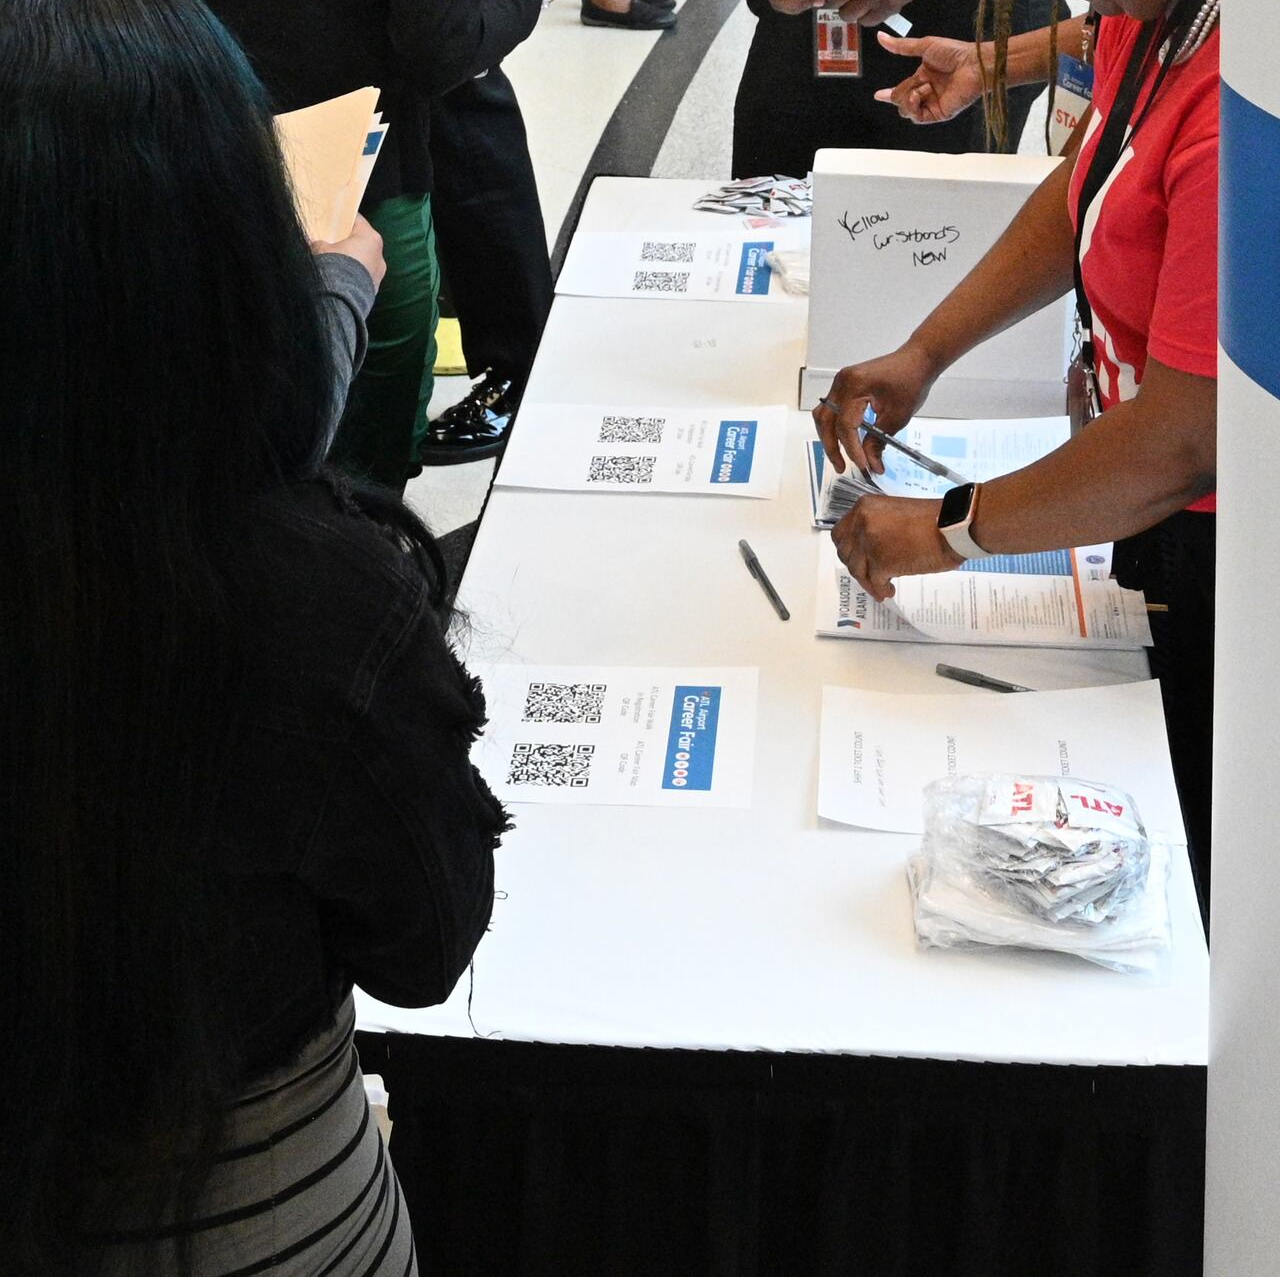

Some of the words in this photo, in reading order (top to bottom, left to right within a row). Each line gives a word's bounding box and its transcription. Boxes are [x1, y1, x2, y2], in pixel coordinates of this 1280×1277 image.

[1055, 108, 1078, 130] STA
[837, 210, 890, 241] Yellow
[725, 427, 740, 449] Career
[722, 450, 737, 464] Fair
[856, 592, 867, 619] ATLANTA
[699, 695, 711, 707] ATL
[681, 695, 699, 730] Career
[696, 708, 709, 730] Airport
[678, 731, 695, 752] Fair
